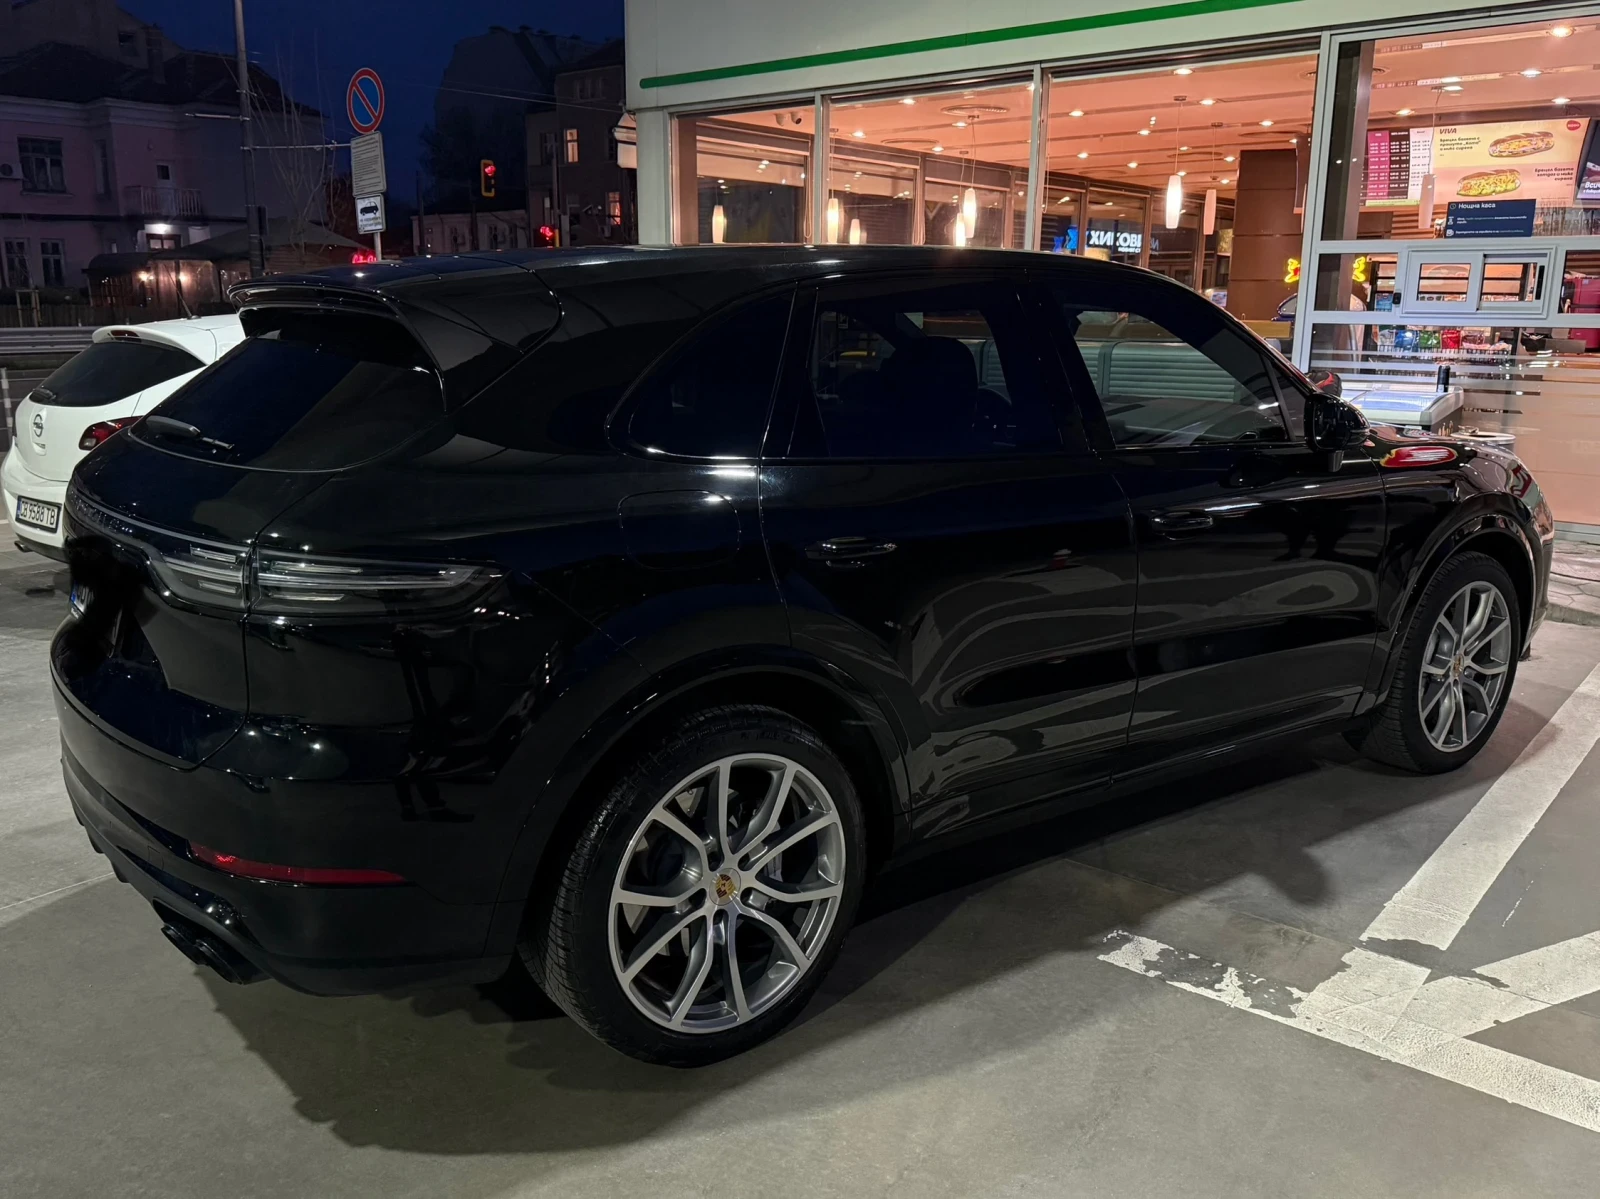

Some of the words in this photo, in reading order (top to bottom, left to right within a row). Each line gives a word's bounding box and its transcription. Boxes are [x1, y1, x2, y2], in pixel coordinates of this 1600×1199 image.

[1439, 127, 1457, 135] VIVA
[28, 503, 44, 523] 9588
[46, 508, 56, 526] TB
